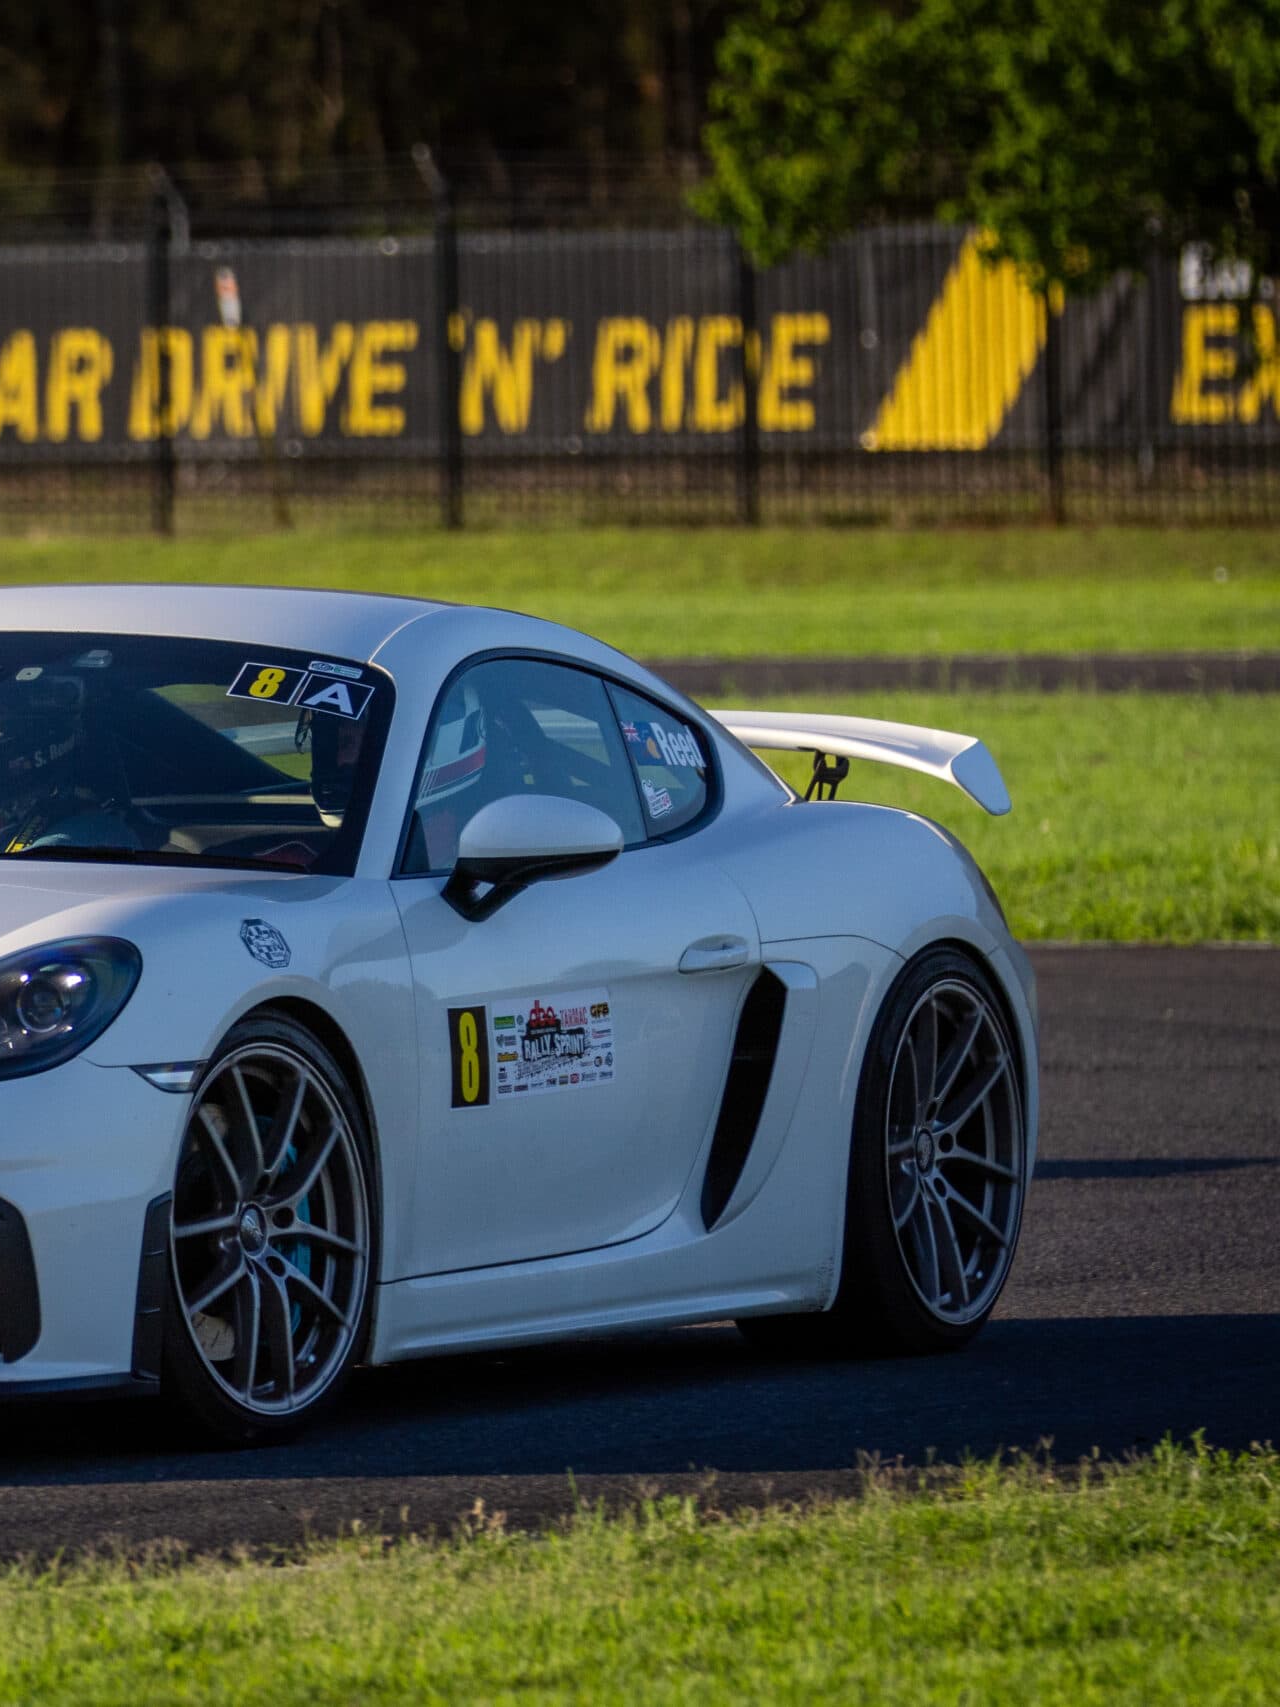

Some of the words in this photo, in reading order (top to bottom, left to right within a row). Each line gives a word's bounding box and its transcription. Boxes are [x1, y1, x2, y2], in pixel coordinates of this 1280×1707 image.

[127, 319, 419, 441] DRIVE
[586, 311, 831, 435] RIDE
[248, 667, 286, 699] 8
[303, 682, 354, 715] A
[649, 721, 707, 768] Reed
[459, 1011, 480, 1103] 8
[523, 1034, 552, 1061] RALLY
